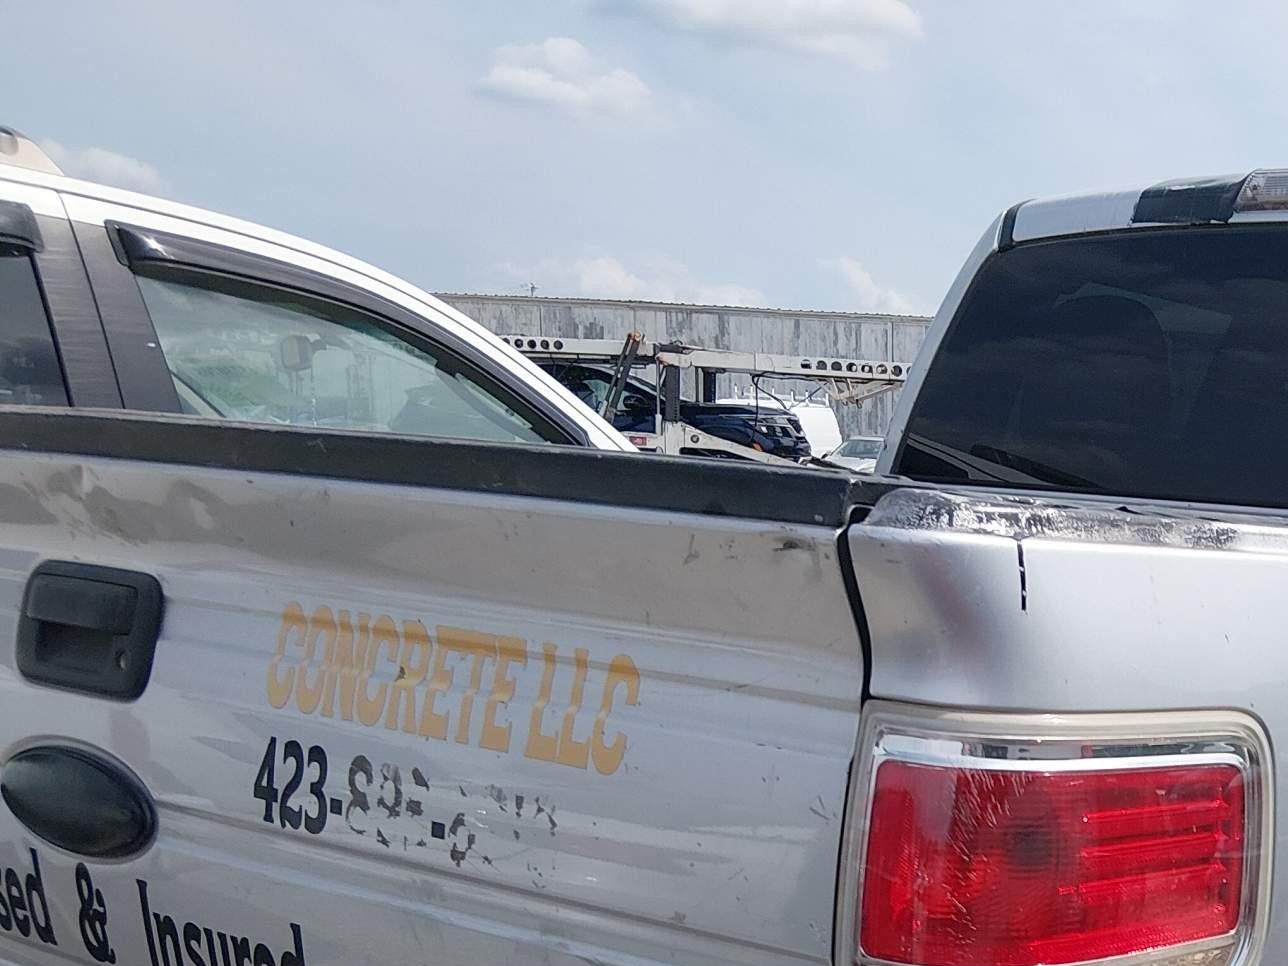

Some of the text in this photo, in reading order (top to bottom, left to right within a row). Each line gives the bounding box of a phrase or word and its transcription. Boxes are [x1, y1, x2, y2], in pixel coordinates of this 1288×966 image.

[266, 602, 640, 775] CONCRETE LLC
[75, 862, 116, 966] &
